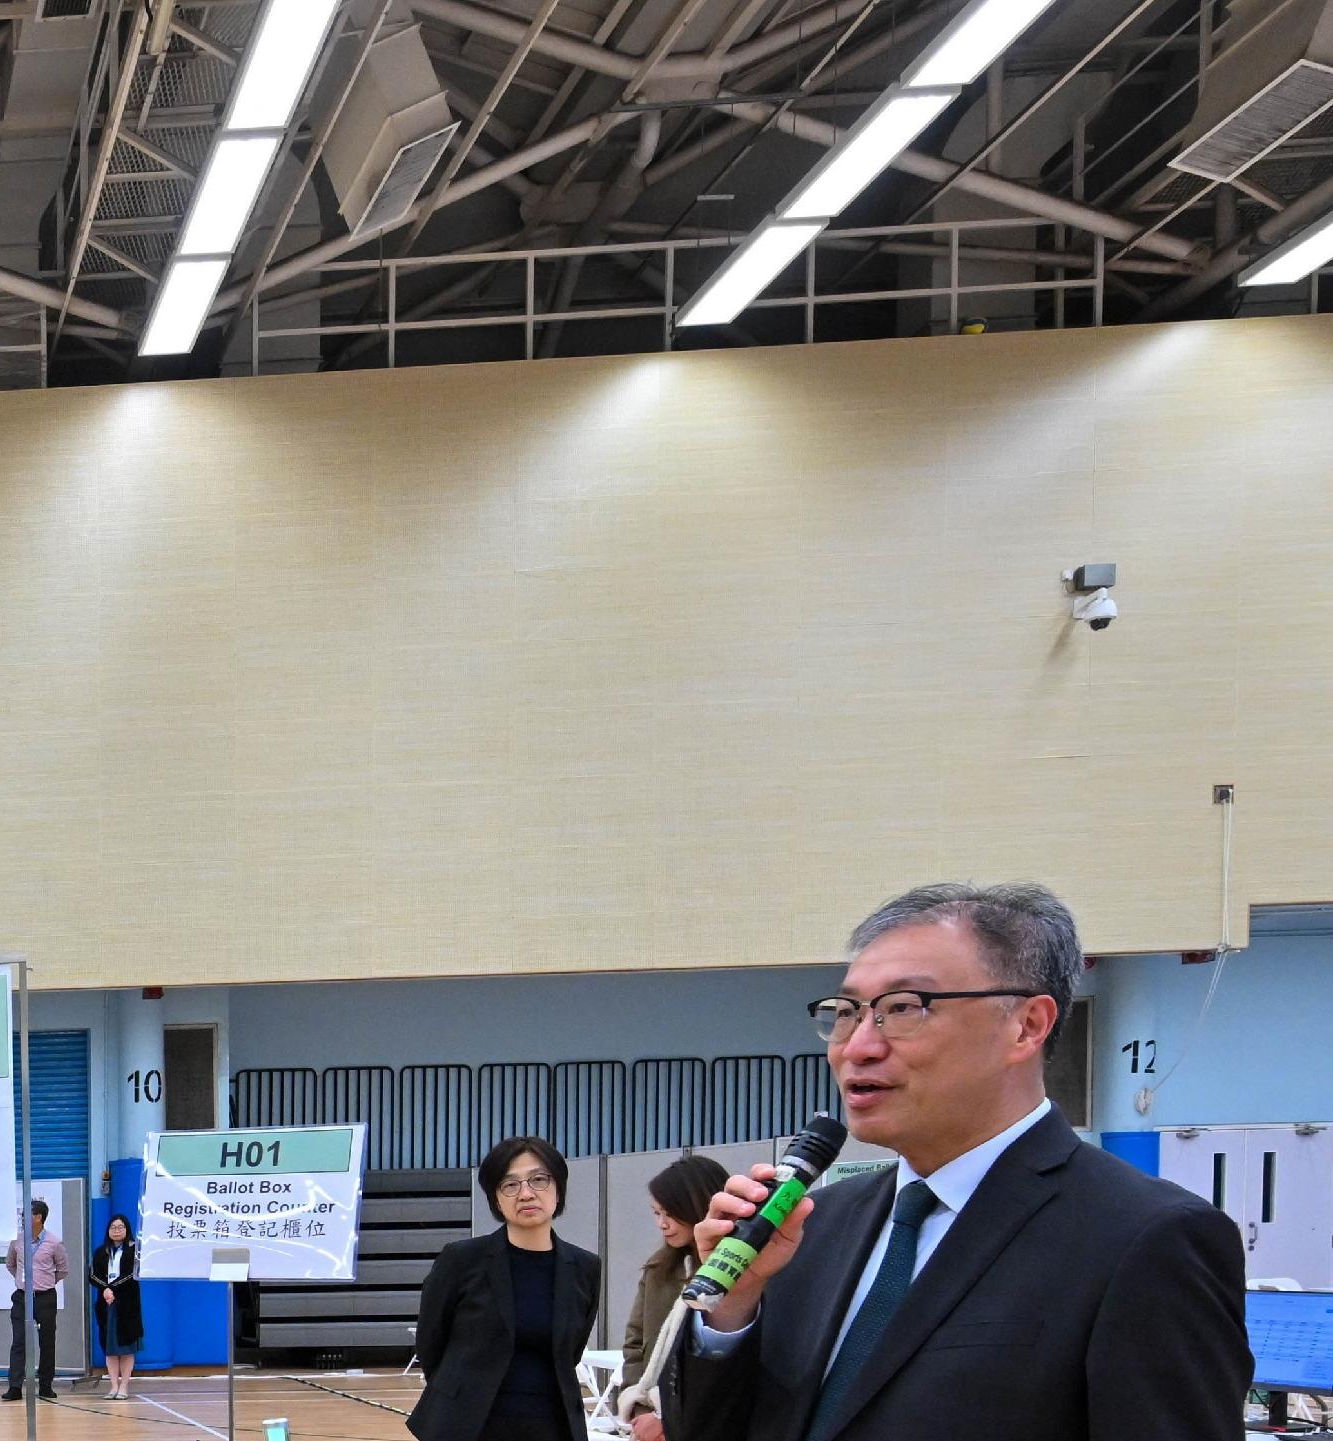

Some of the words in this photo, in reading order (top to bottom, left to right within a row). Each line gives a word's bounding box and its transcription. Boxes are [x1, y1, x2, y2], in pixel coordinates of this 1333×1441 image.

[1122, 1040, 1156, 1073] 12
[127, 1070, 162, 1103] 10
[219, 1140, 281, 1168] H01
[206, 1182, 254, 1194] Ballot
[259, 1180, 291, 1193] Box
